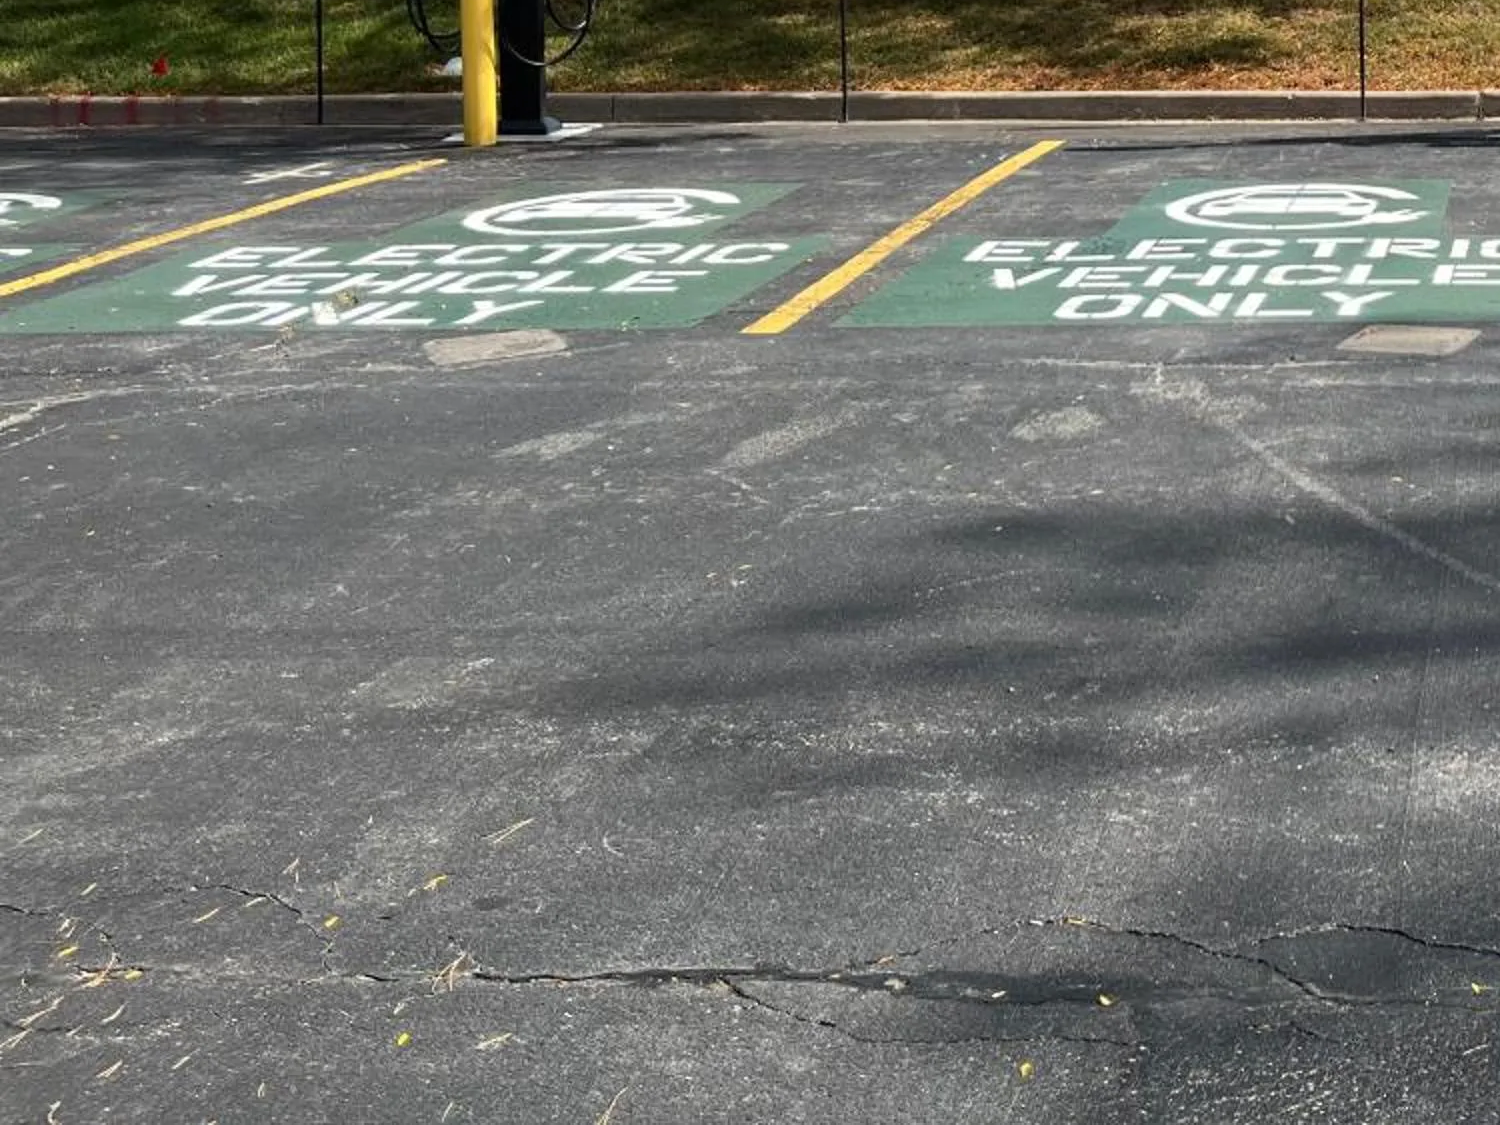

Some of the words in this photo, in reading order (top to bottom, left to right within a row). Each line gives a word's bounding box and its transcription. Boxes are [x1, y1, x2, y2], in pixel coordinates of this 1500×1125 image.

[187, 242, 789, 268] ELECTRIC
[171, 270, 709, 296] VEHICLE
[177, 299, 543, 326] ONLY
[1052, 291, 1395, 319] ONLY
